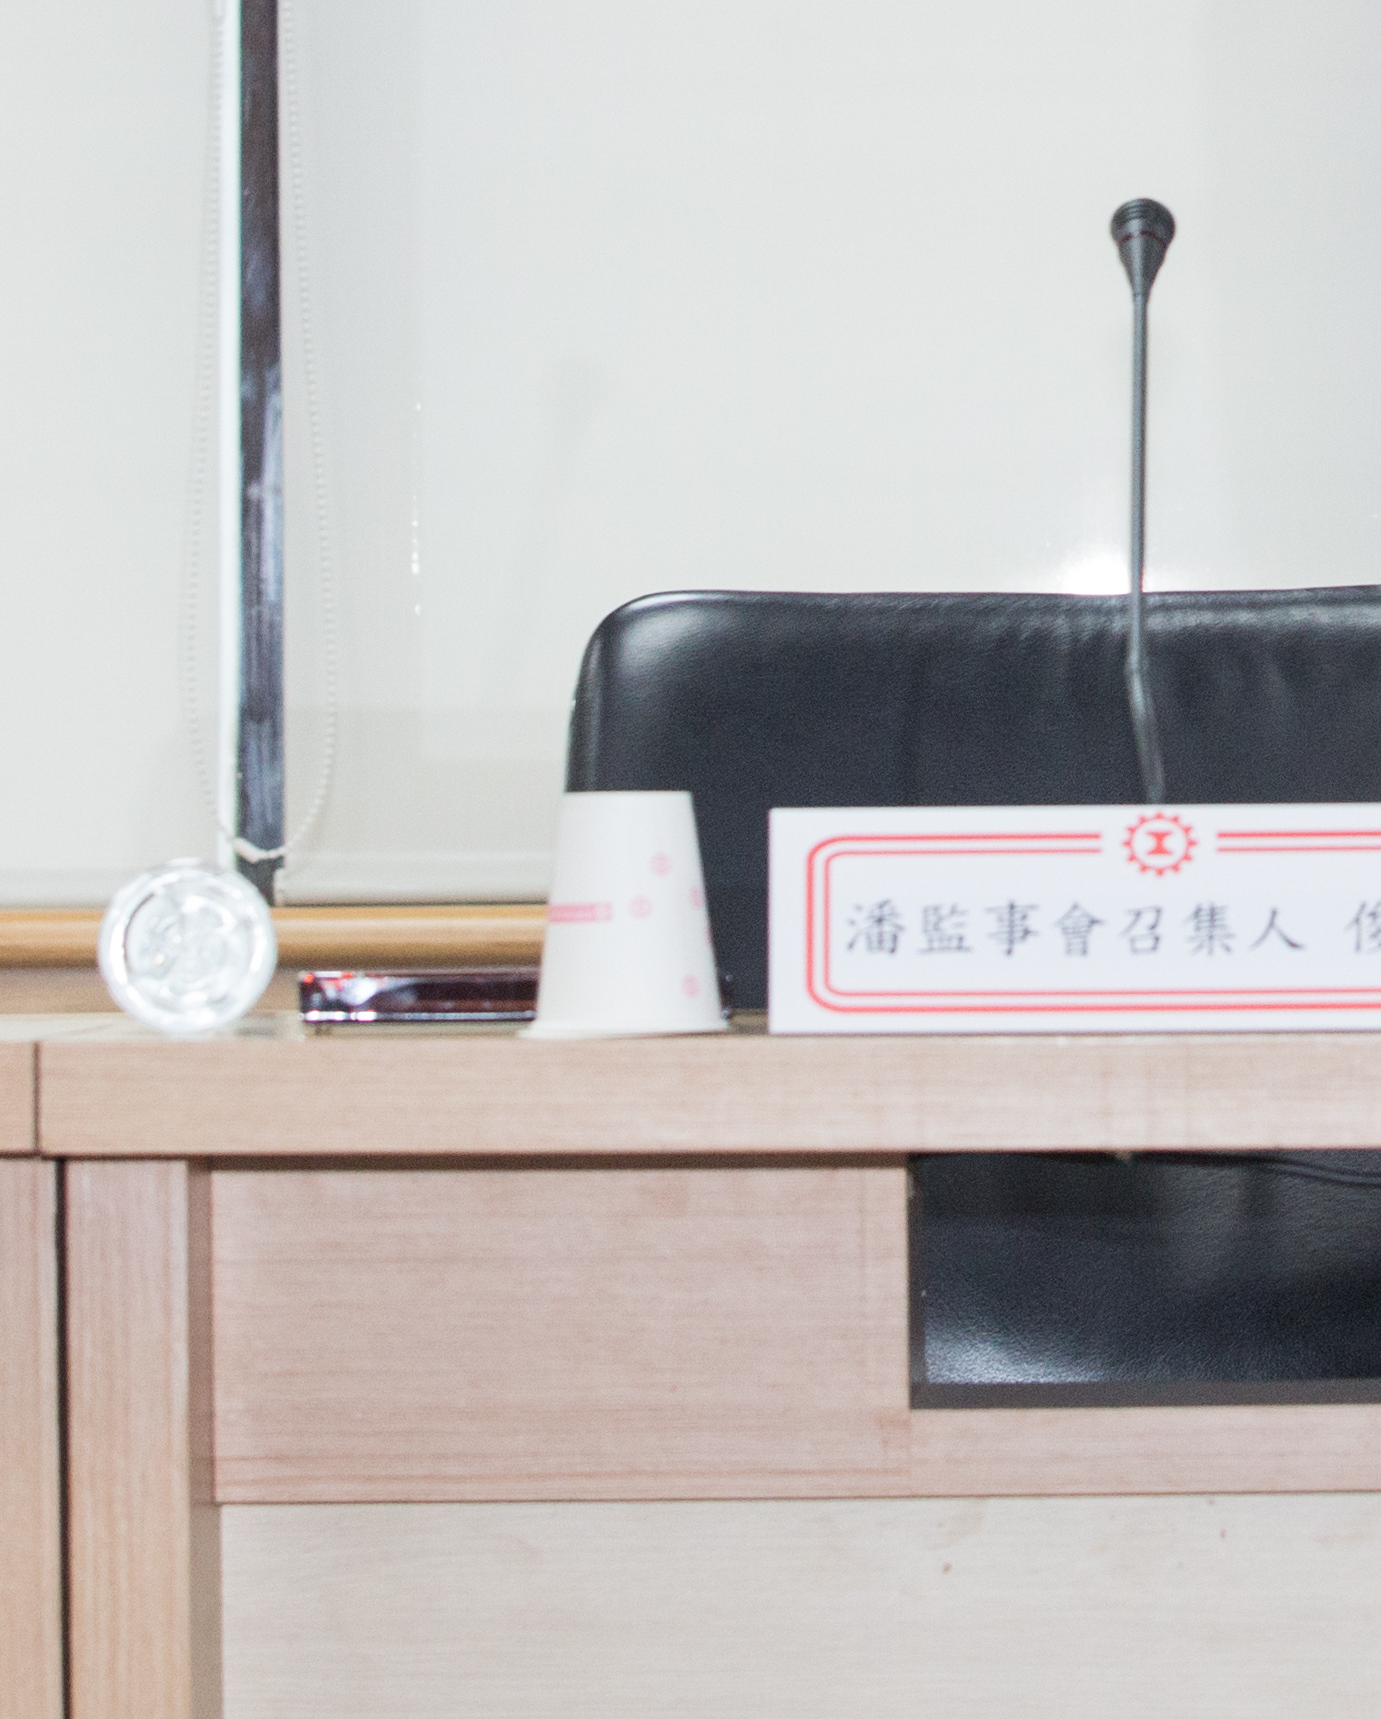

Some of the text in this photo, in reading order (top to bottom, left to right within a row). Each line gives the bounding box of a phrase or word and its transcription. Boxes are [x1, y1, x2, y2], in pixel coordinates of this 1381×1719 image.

[846, 899, 1305, 956] 潘監事會召集人
